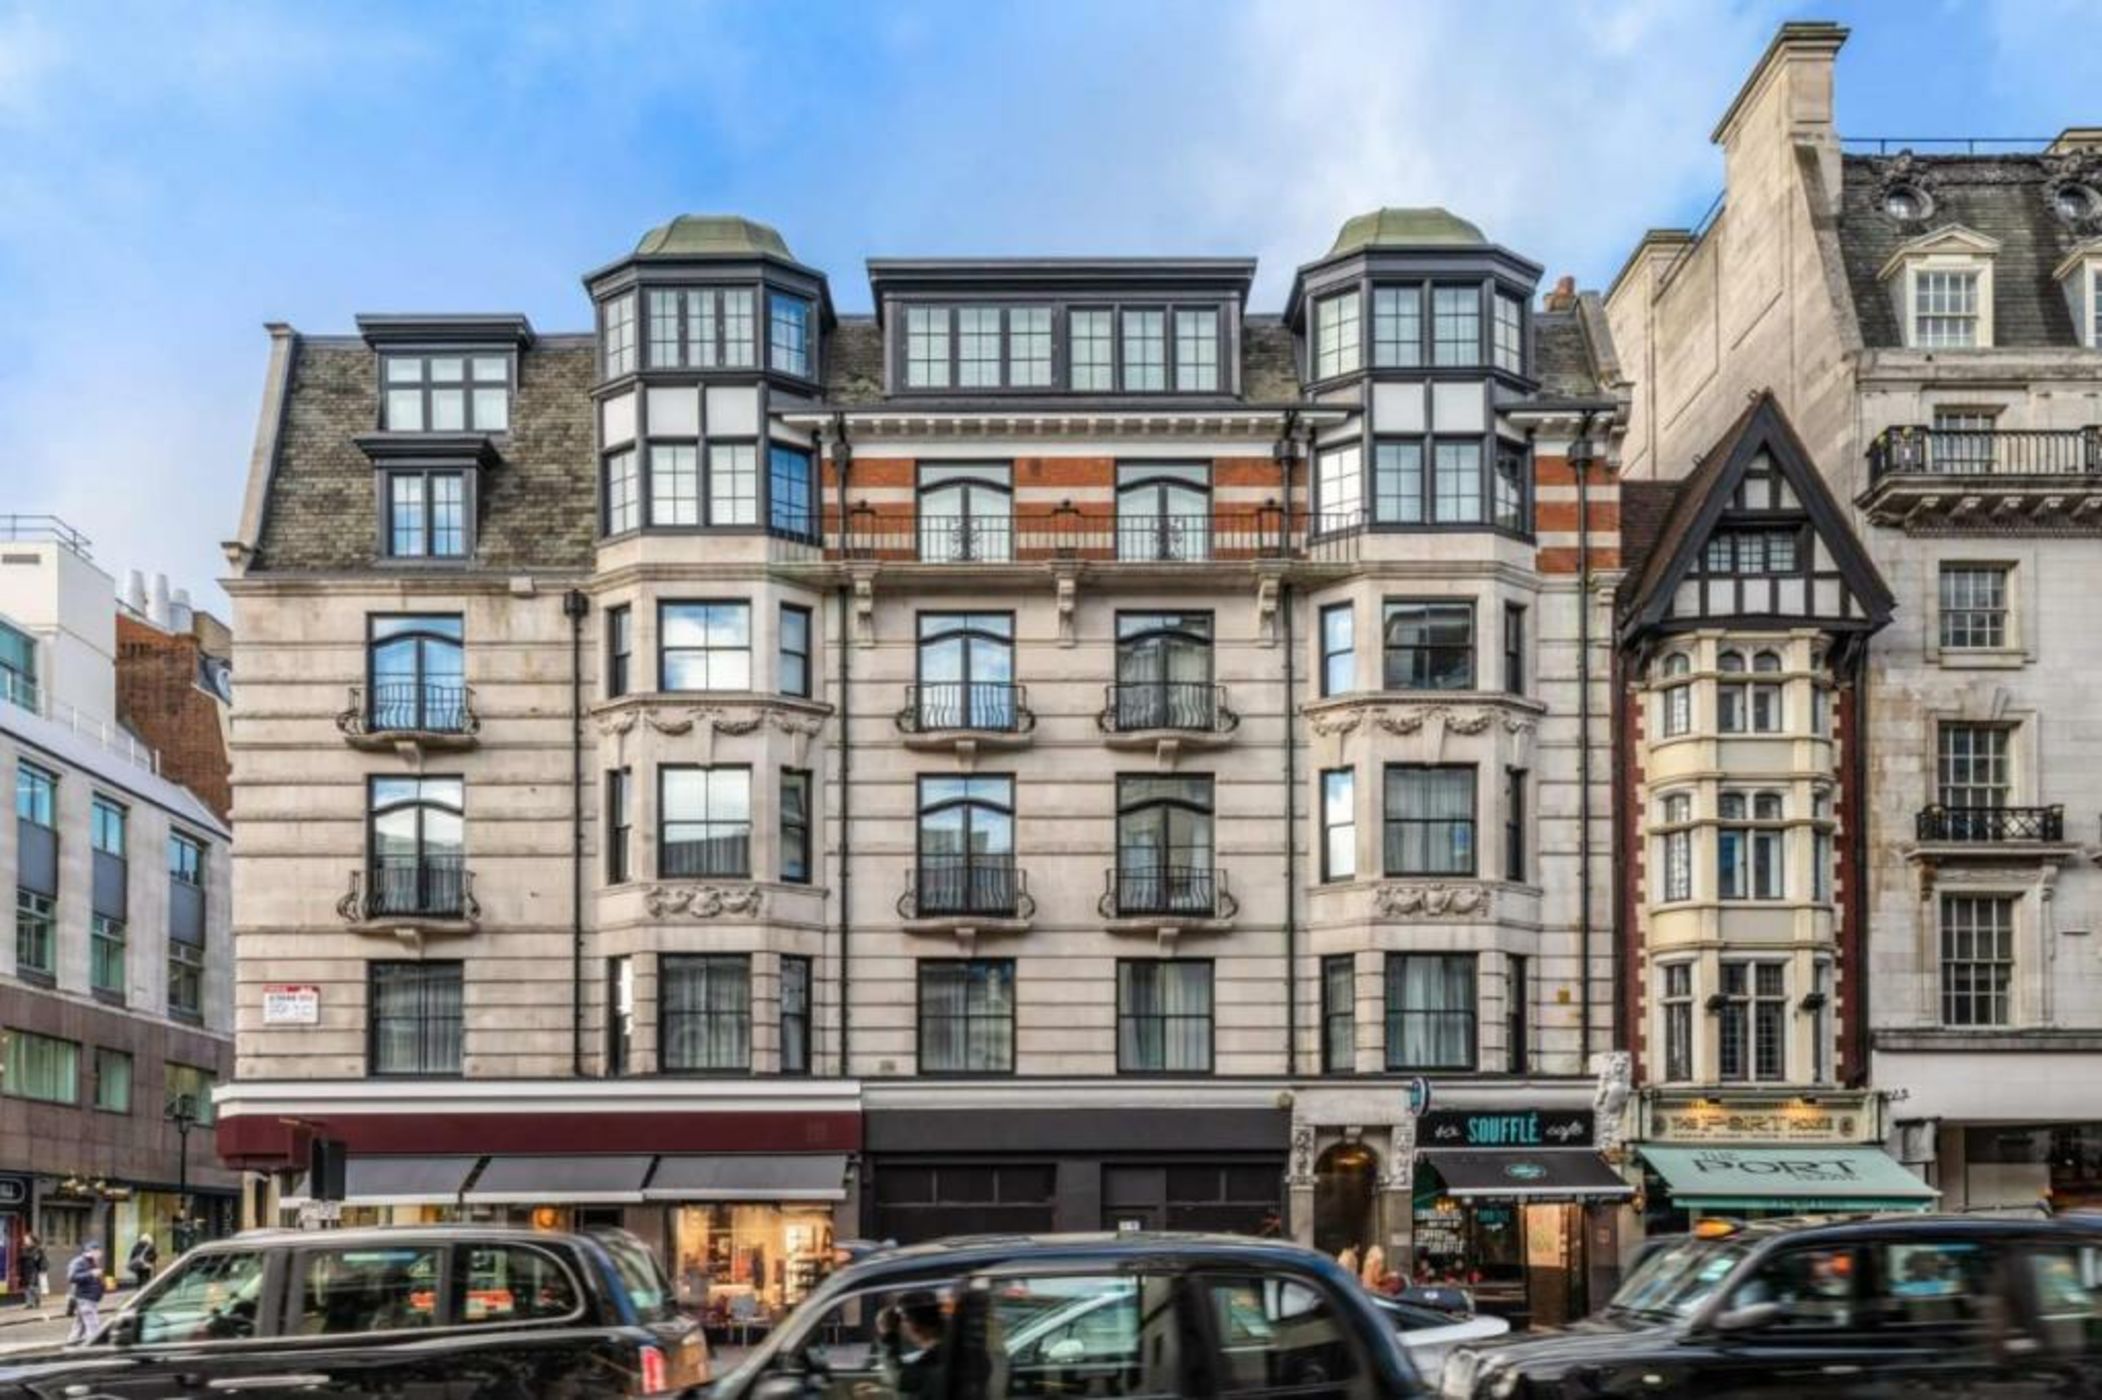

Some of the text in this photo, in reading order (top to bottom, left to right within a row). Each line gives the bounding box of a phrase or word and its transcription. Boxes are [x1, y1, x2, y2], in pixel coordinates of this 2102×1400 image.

[1468, 1113, 1541, 1143] SOUFFLÉ
[1701, 1115, 1786, 1131] PORT
[1693, 1159, 1857, 1175] PORT
